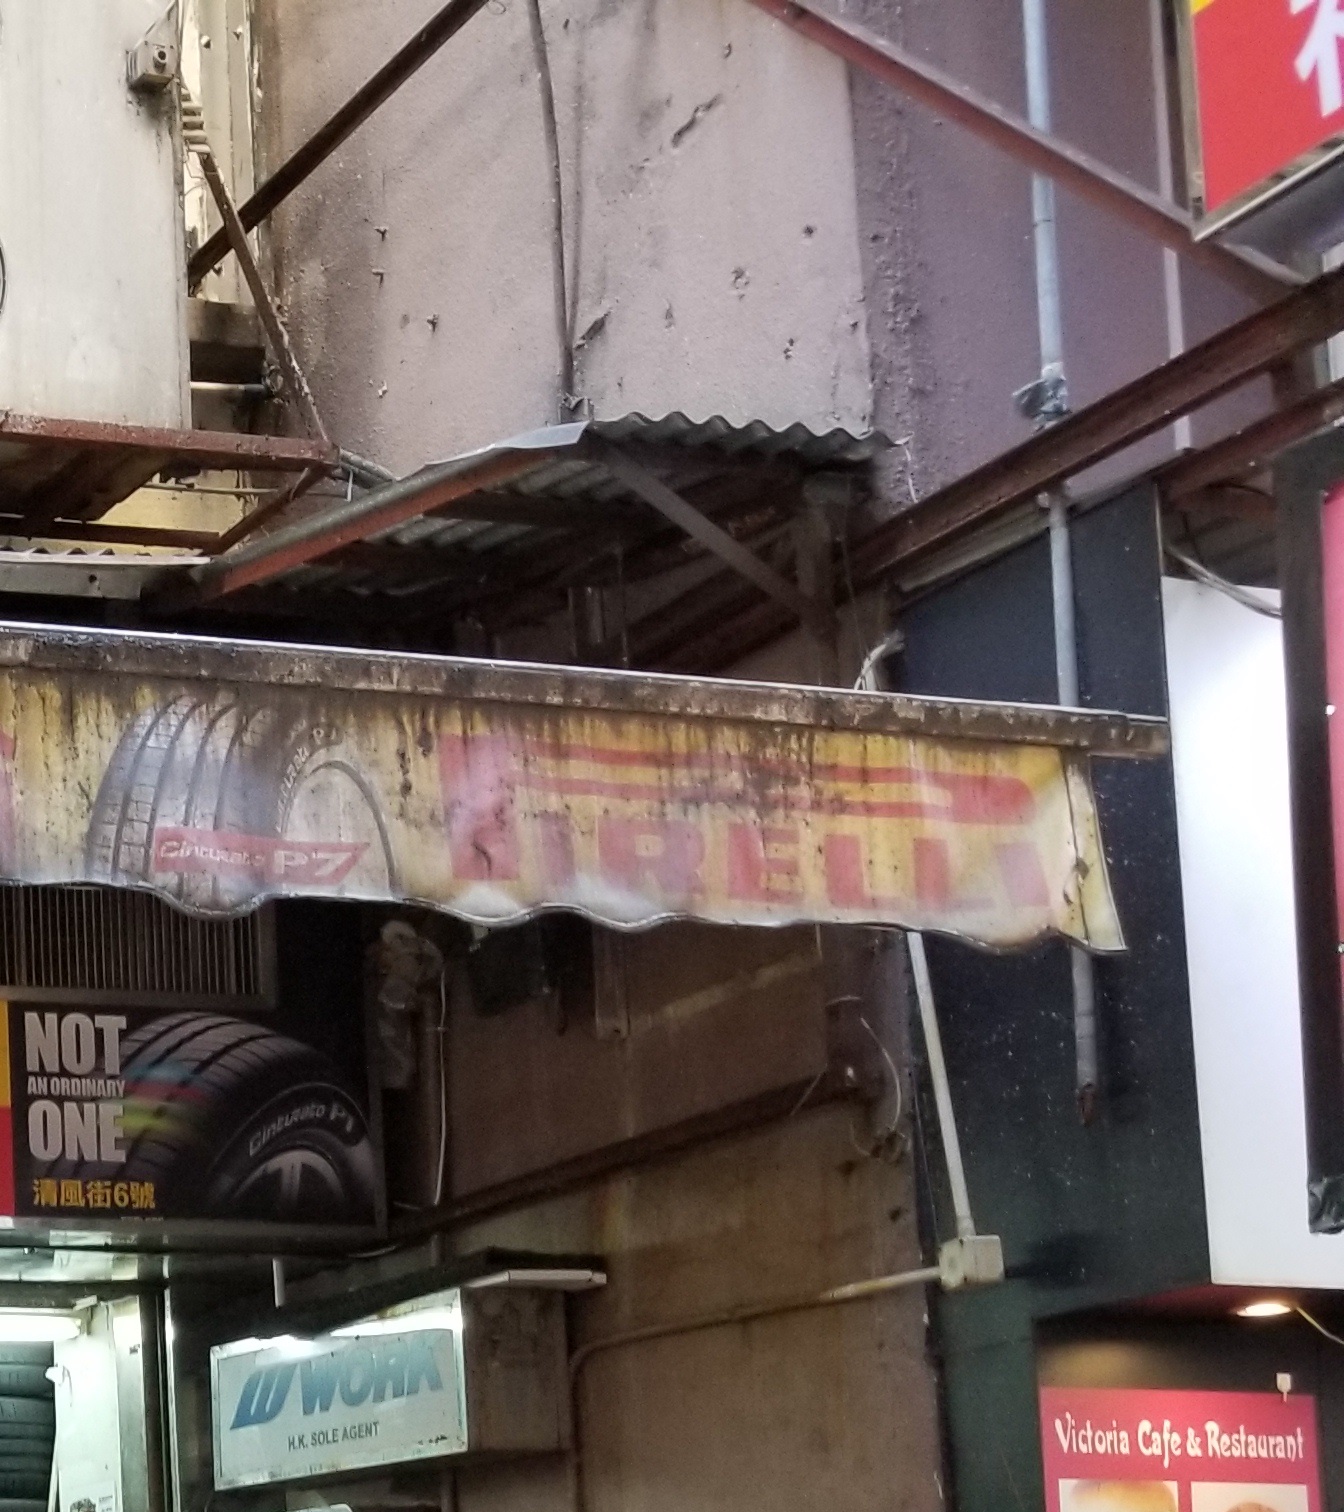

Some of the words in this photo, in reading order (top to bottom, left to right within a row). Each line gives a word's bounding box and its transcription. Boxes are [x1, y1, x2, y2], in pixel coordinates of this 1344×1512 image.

[438, 733, 1051, 908] PIRELLI
[273, 850, 353, 878] P7
[23, 1011, 127, 1076] NOT
[27, 1075, 48, 1096] AN
[50, 1076, 126, 1098] ORDINARY
[27, 1099, 127, 1163] ONE
[302, 1333, 444, 1417] WORK
[287, 1431, 309, 1453] H.K.
[310, 1426, 339, 1447] SOLE
[341, 1421, 380, 1442] AGENT
[1054, 1411, 1131, 1456] Victoria
[1137, 1418, 1182, 1468] Cafe
[1186, 1427, 1203, 1458] &
[1205, 1420, 1304, 1462] Restaurant
